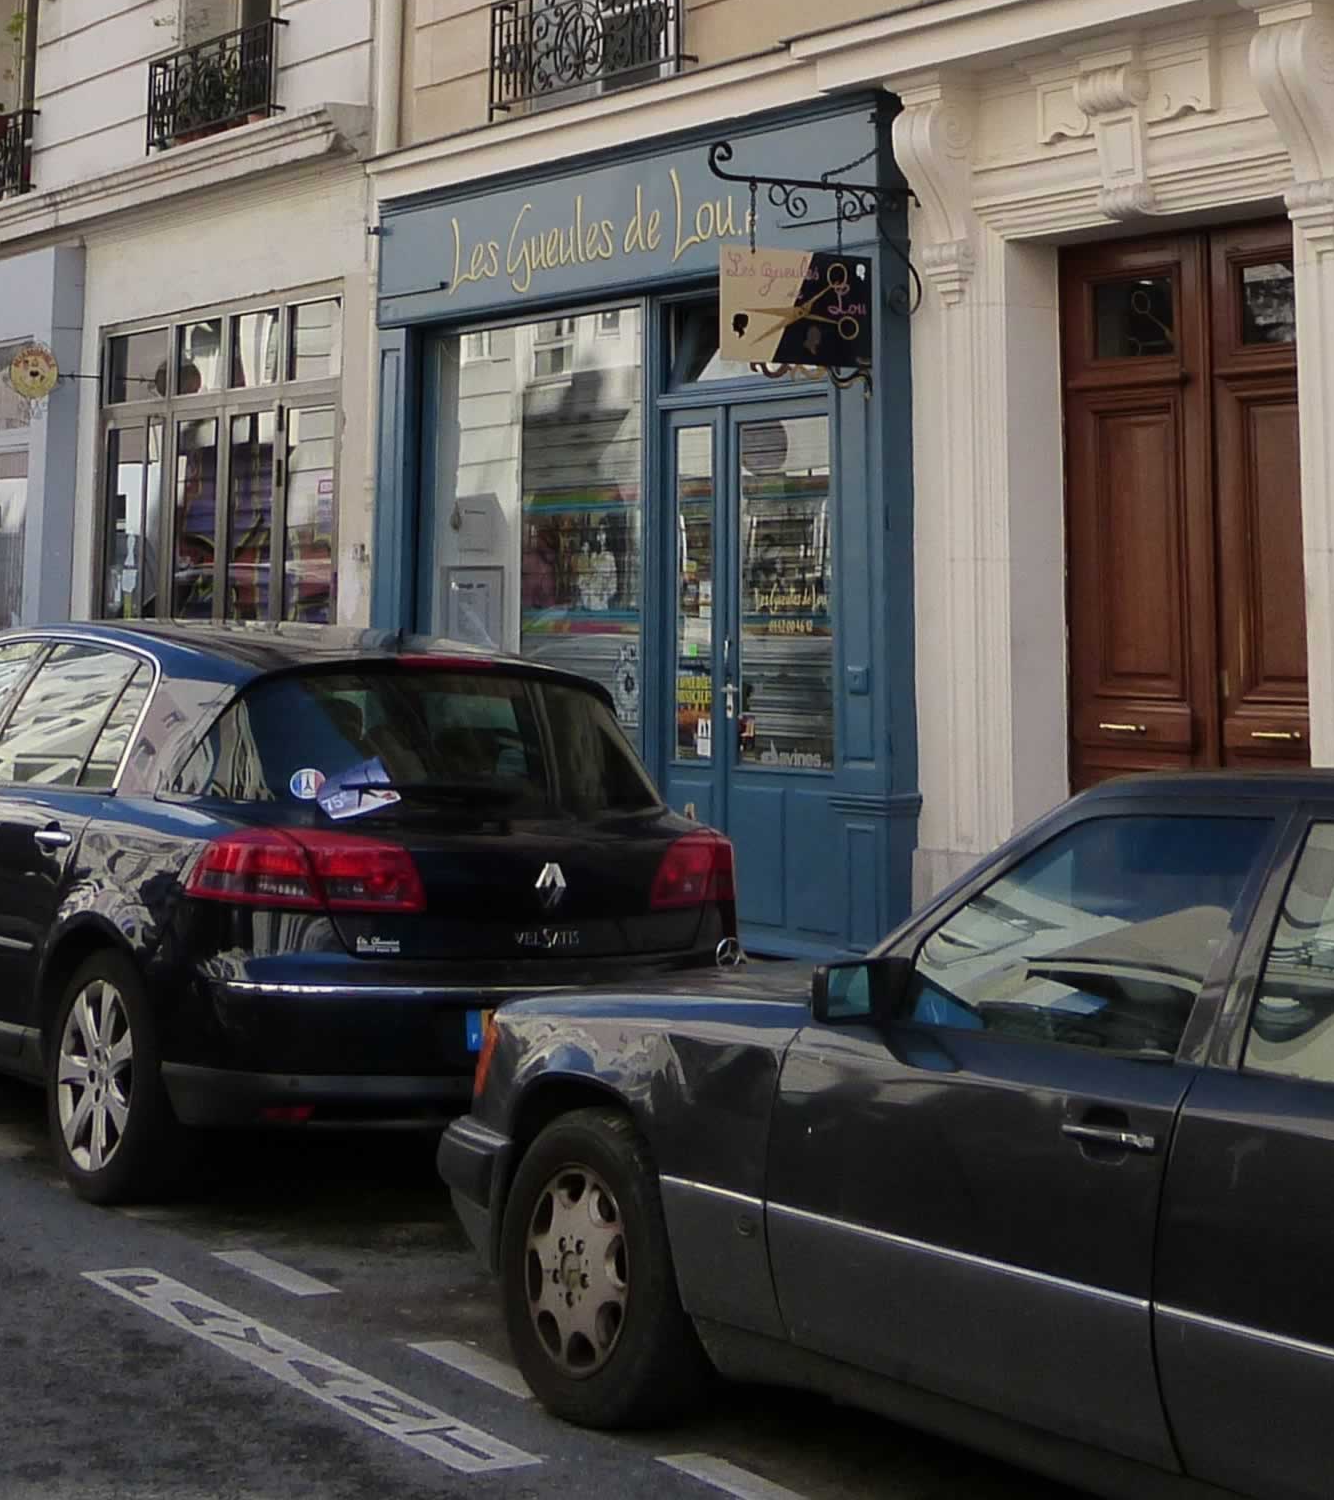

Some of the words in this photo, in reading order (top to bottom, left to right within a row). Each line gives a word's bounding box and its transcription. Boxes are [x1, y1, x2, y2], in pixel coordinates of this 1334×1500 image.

[449, 217, 499, 295] Les
[506, 195, 613, 293] Gueules
[623, 184, 662, 252] de
[104, 1275, 496, 1461] PAYANT
